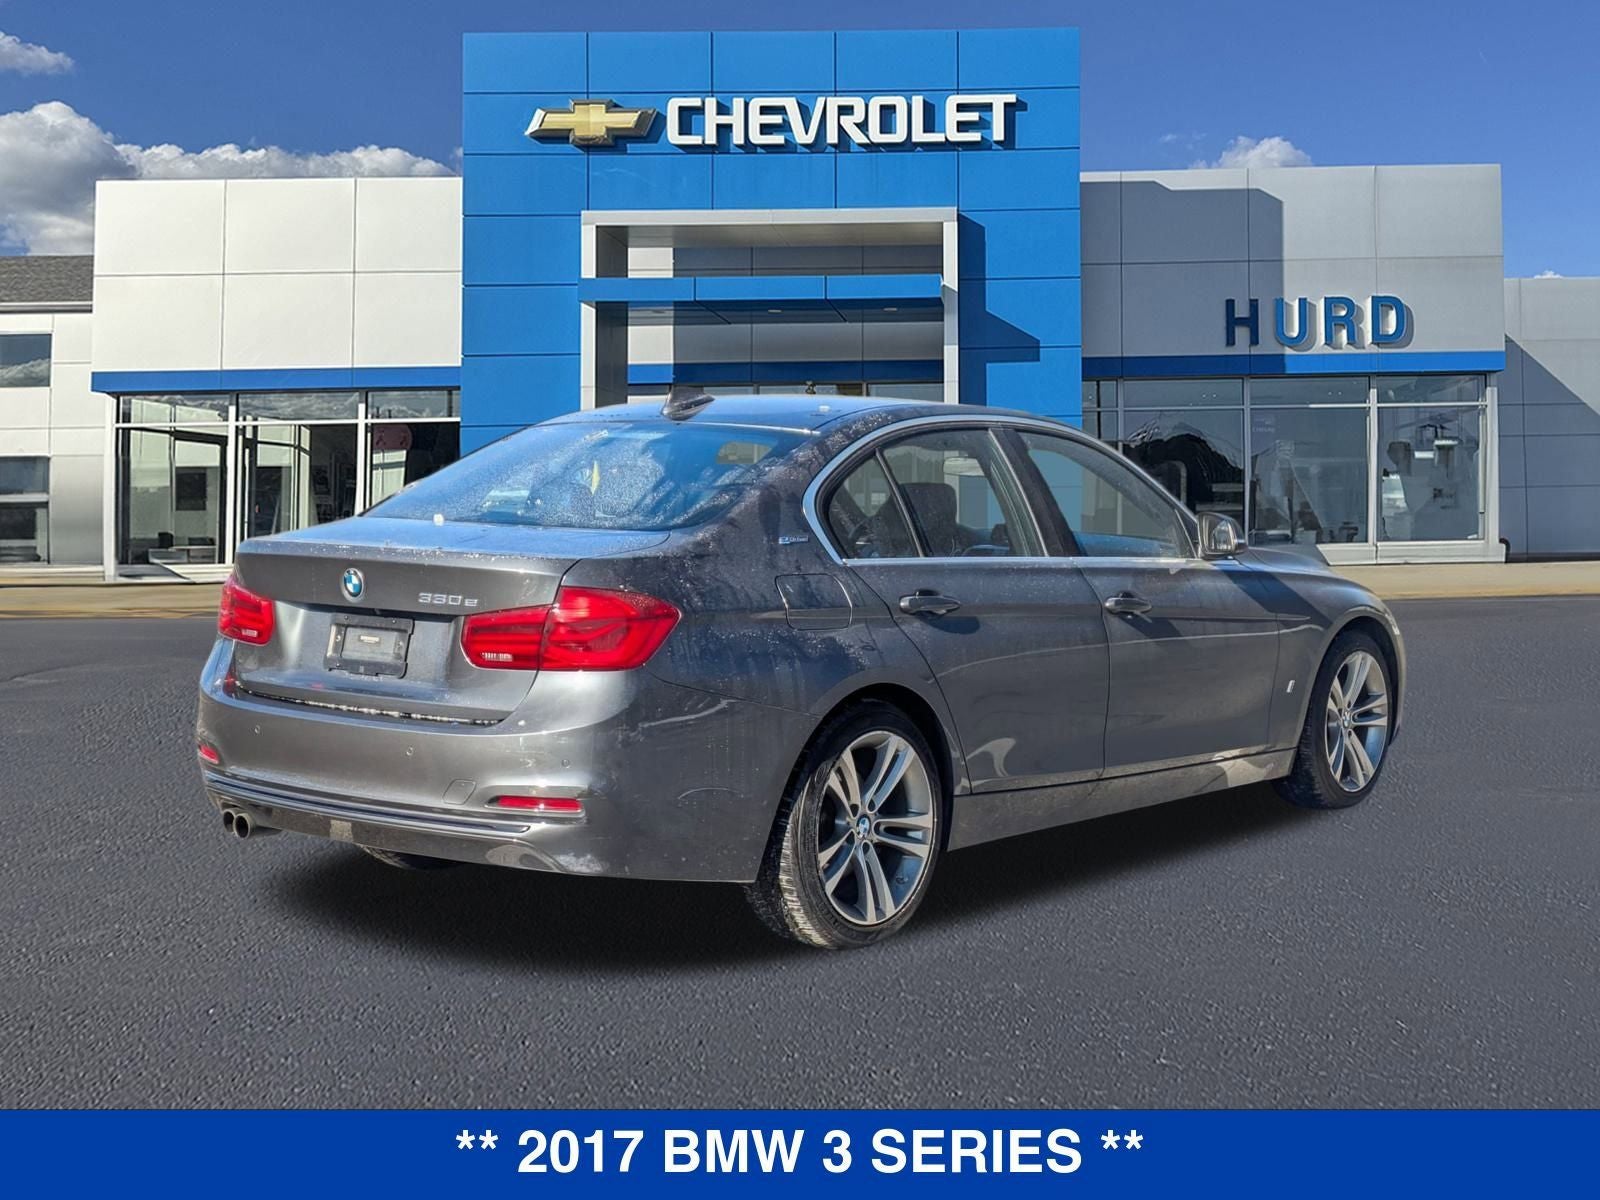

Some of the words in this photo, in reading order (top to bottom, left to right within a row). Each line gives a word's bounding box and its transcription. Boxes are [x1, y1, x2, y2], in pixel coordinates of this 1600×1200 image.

[665, 94, 1018, 146] CHEVROLET
[1225, 294, 1408, 347] HURD
[418, 592, 479, 607] 330e
